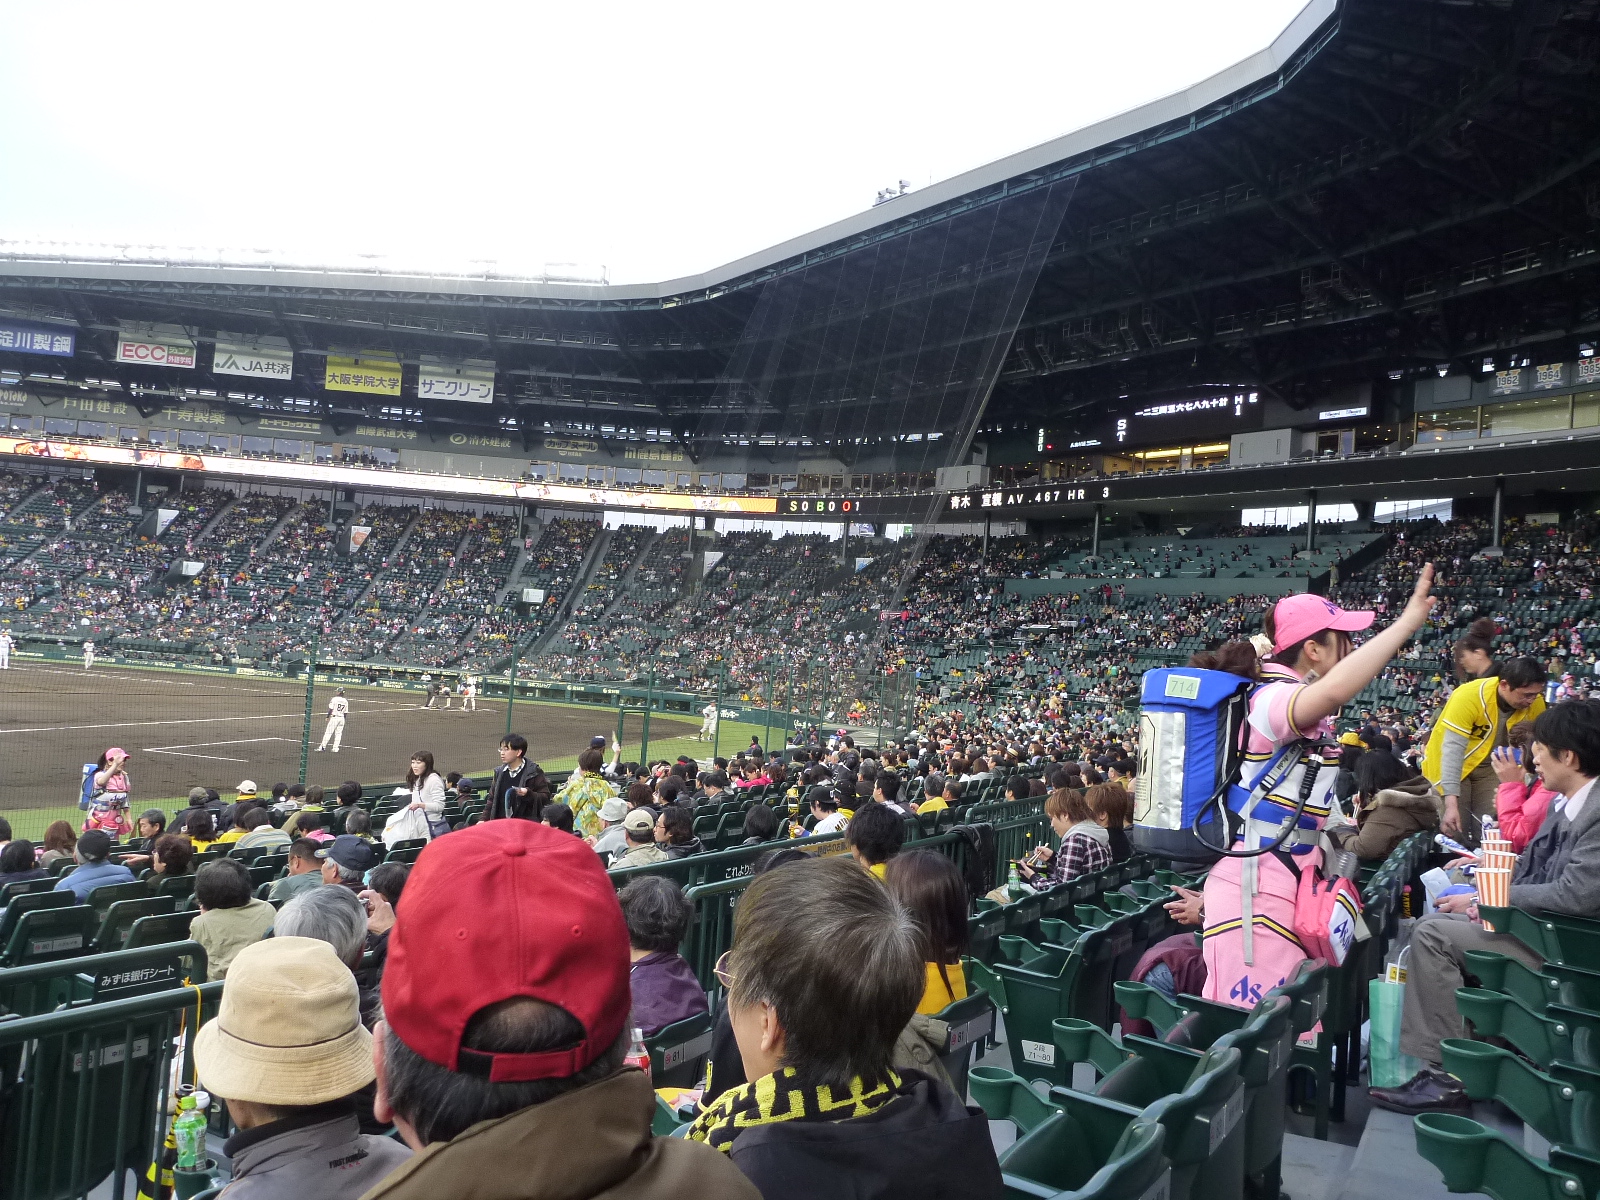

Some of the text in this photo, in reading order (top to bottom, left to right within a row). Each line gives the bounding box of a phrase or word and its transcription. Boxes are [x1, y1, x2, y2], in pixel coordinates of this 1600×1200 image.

[122, 343, 166, 361] ECC
[242, 360, 291, 375] JA共済
[1579, 362, 1600, 375] 1985
[328, 372, 399, 390] 大阪学院大学
[1497, 374, 1520, 388] 1962
[1537, 369, 1560, 382] 1964
[421, 379, 491, 399] サニクリーン
[63, 396, 128, 415] 戸田建設
[1234, 395, 1243, 404] H
[1249, 393, 1258, 403] E
[161, 406, 226, 425] 千寿製薬
[1234, 405, 1241, 416] 1
[1117, 419, 1127, 430] S
[1116, 431, 1126, 441] T
[950, 496, 971, 509] 青木
[1007, 493, 1024, 505] AV
[1028, 490, 1061, 503] .467
[1067, 489, 1085, 500] HR
[1102, 487, 1110, 498] 3
[1171, 680, 1195, 695] 714
[337, 703, 346, 713] 87
[101, 965, 175, 987] みずほ銀行シート
[1033, 1043, 1046, 1053] 2段
[672, 1051, 680, 1062] 81
